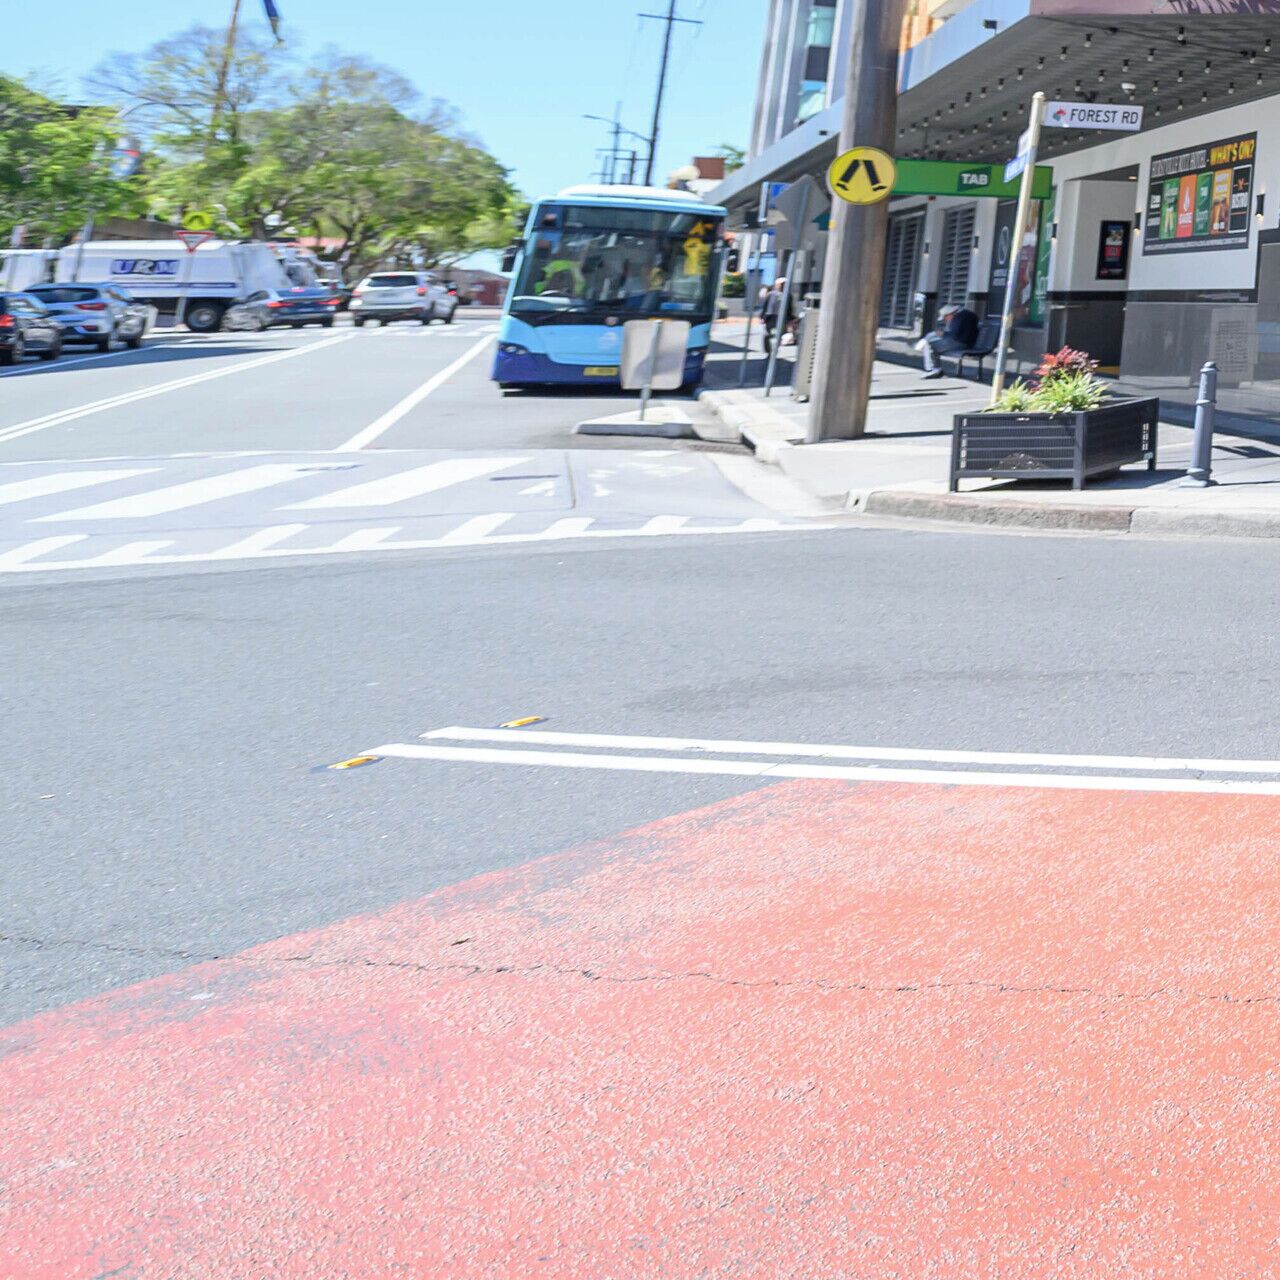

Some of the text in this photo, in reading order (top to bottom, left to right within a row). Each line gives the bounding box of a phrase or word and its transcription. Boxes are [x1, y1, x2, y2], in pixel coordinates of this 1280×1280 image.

[1070, 108, 1139, 125] FOREST RD
[961, 173, 988, 186] TAB
